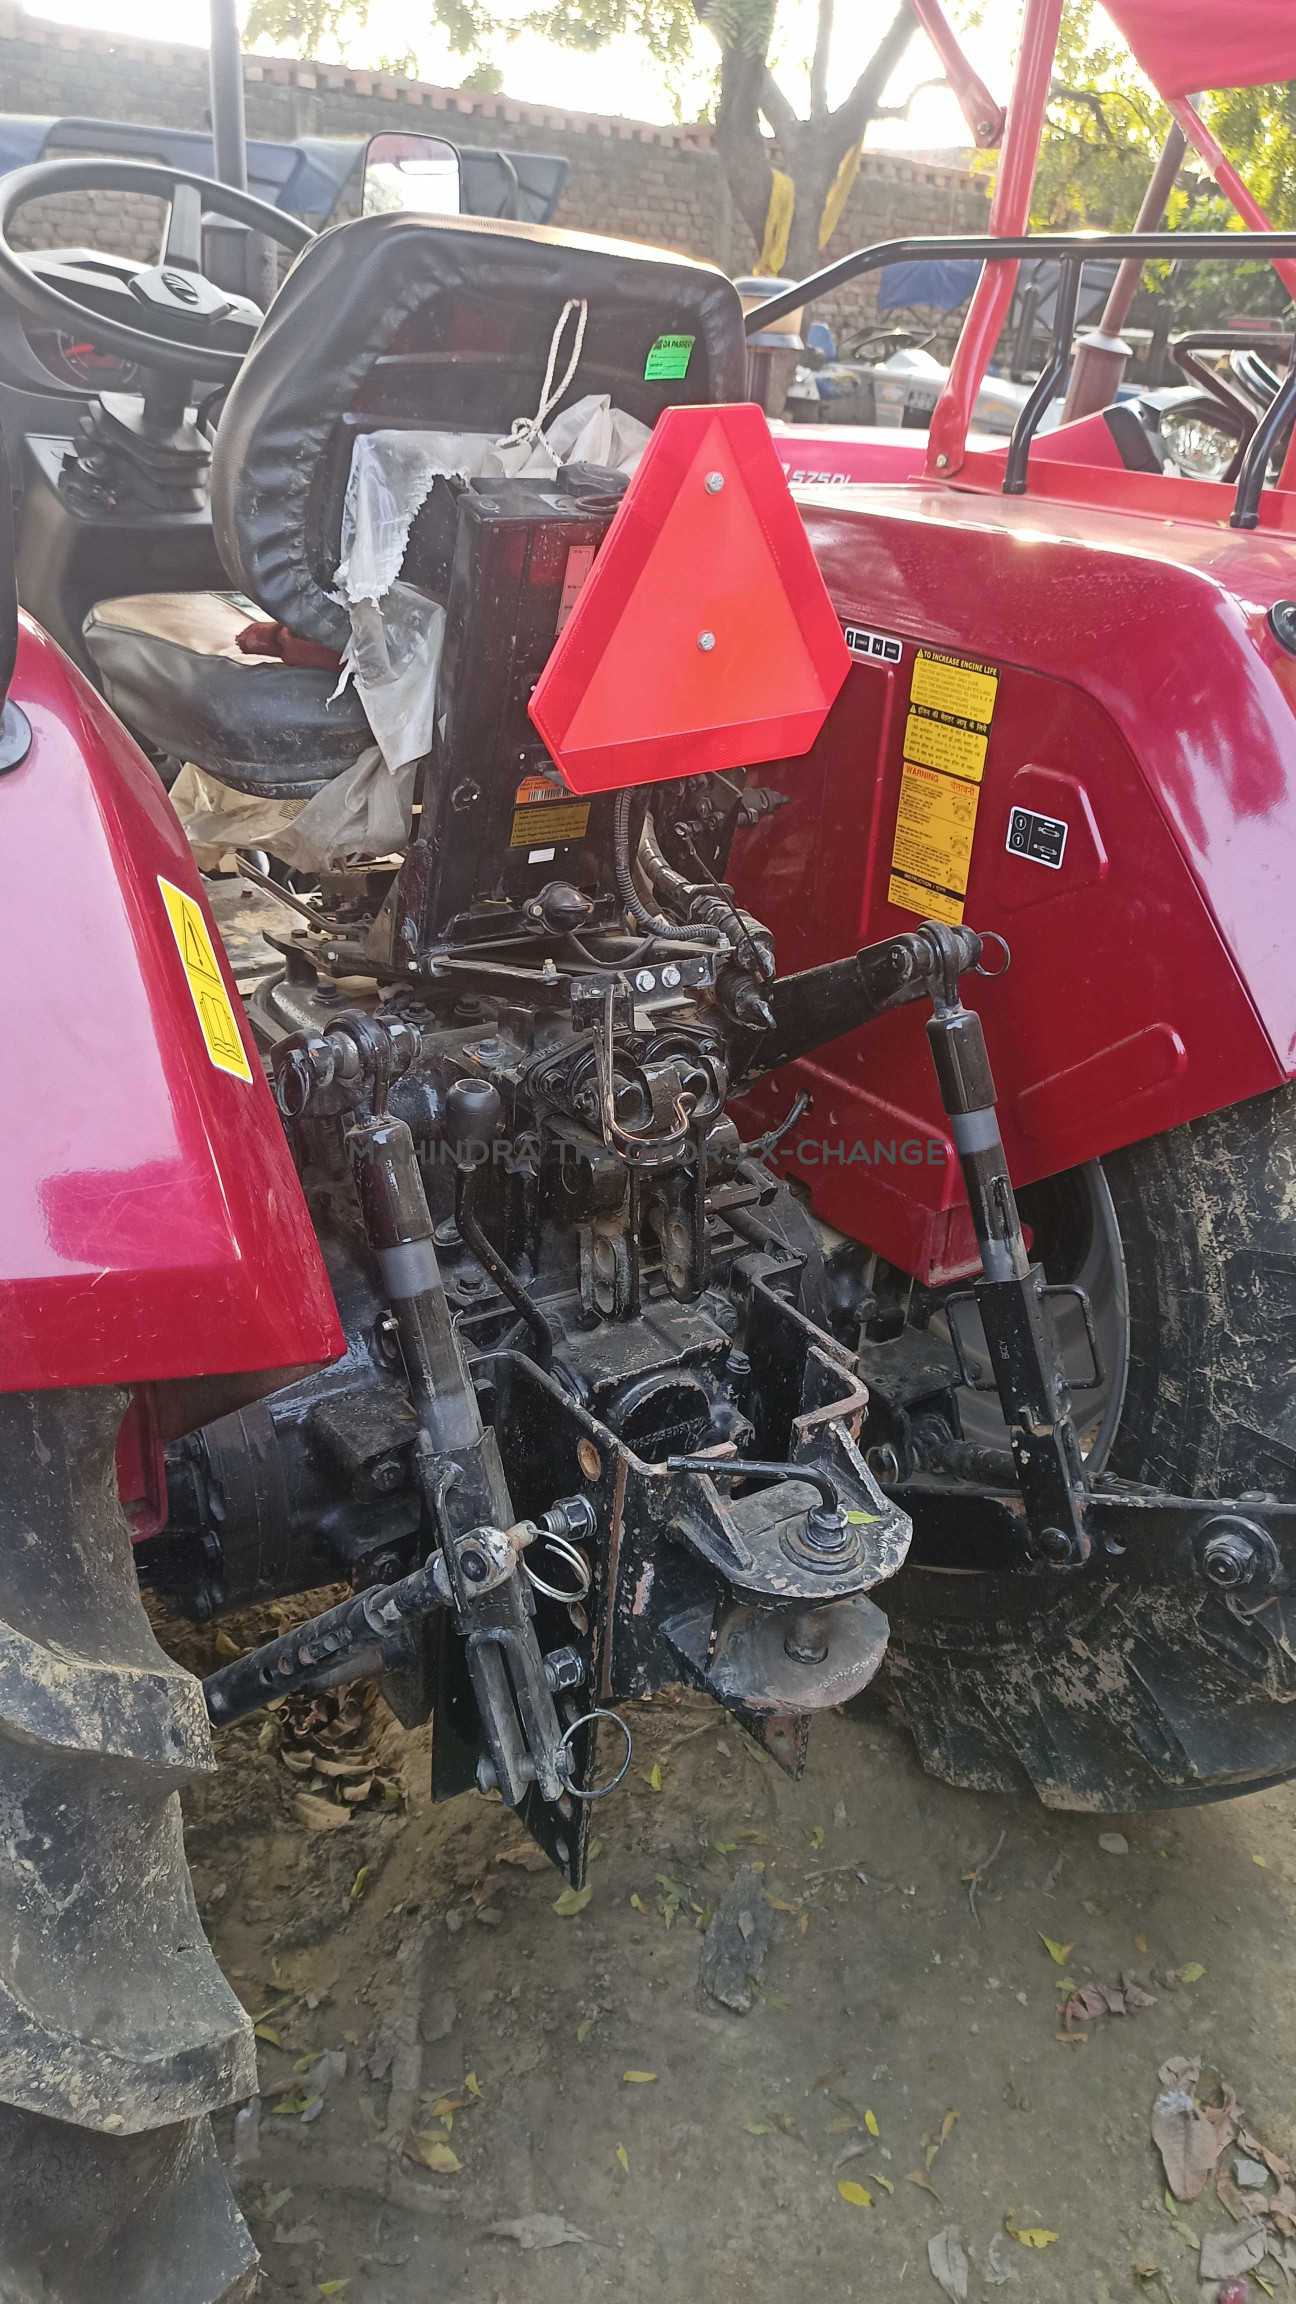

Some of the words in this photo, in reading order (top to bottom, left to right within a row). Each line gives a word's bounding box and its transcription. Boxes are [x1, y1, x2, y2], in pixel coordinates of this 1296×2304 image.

[875, 643, 881, 651] N
[923, 650, 931, 658] TO
[932, 652, 959, 666] INCREASE
[960, 659, 982, 672] ENGINE
[983, 665, 997, 676] LIFE
[905, 764, 938, 783] WARNING
[949, 778, 975, 796] चेतावनी
